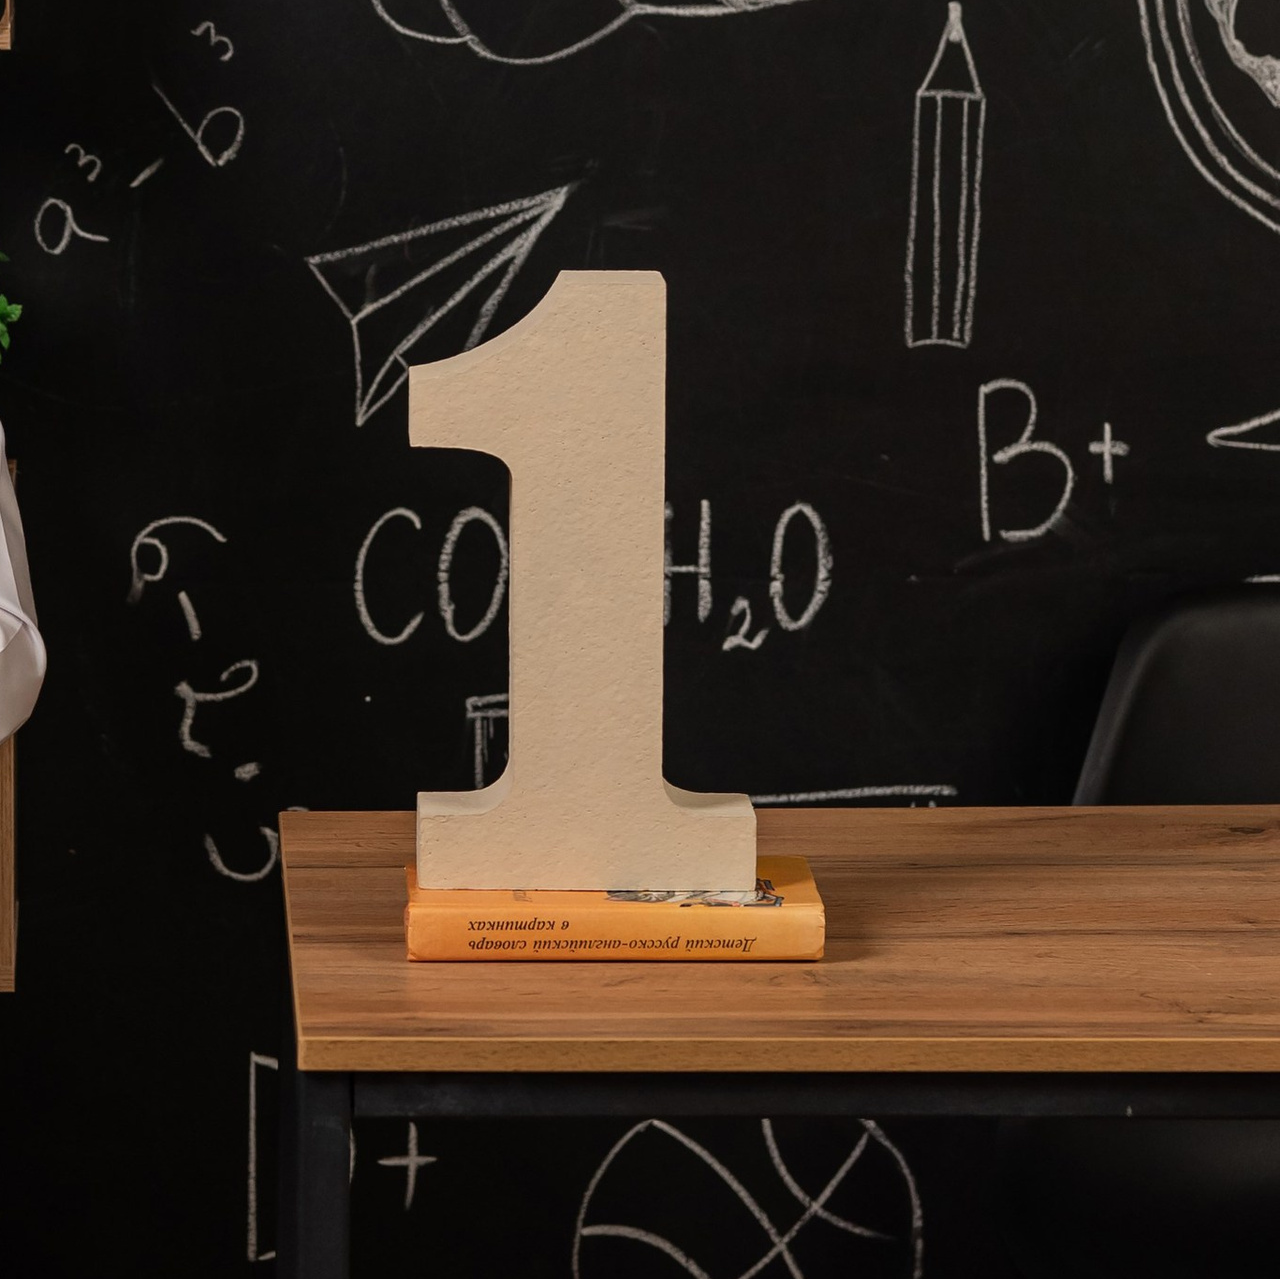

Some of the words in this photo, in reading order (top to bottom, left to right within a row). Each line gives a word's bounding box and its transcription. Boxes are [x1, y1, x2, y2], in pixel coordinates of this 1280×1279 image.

[467, 918, 556, 933] картинках
[560, 921, 570, 932] в
[468, 937, 527, 951] словарь
[532, 936, 680, 954] русско-английский
[686, 936, 756, 954] Детский
